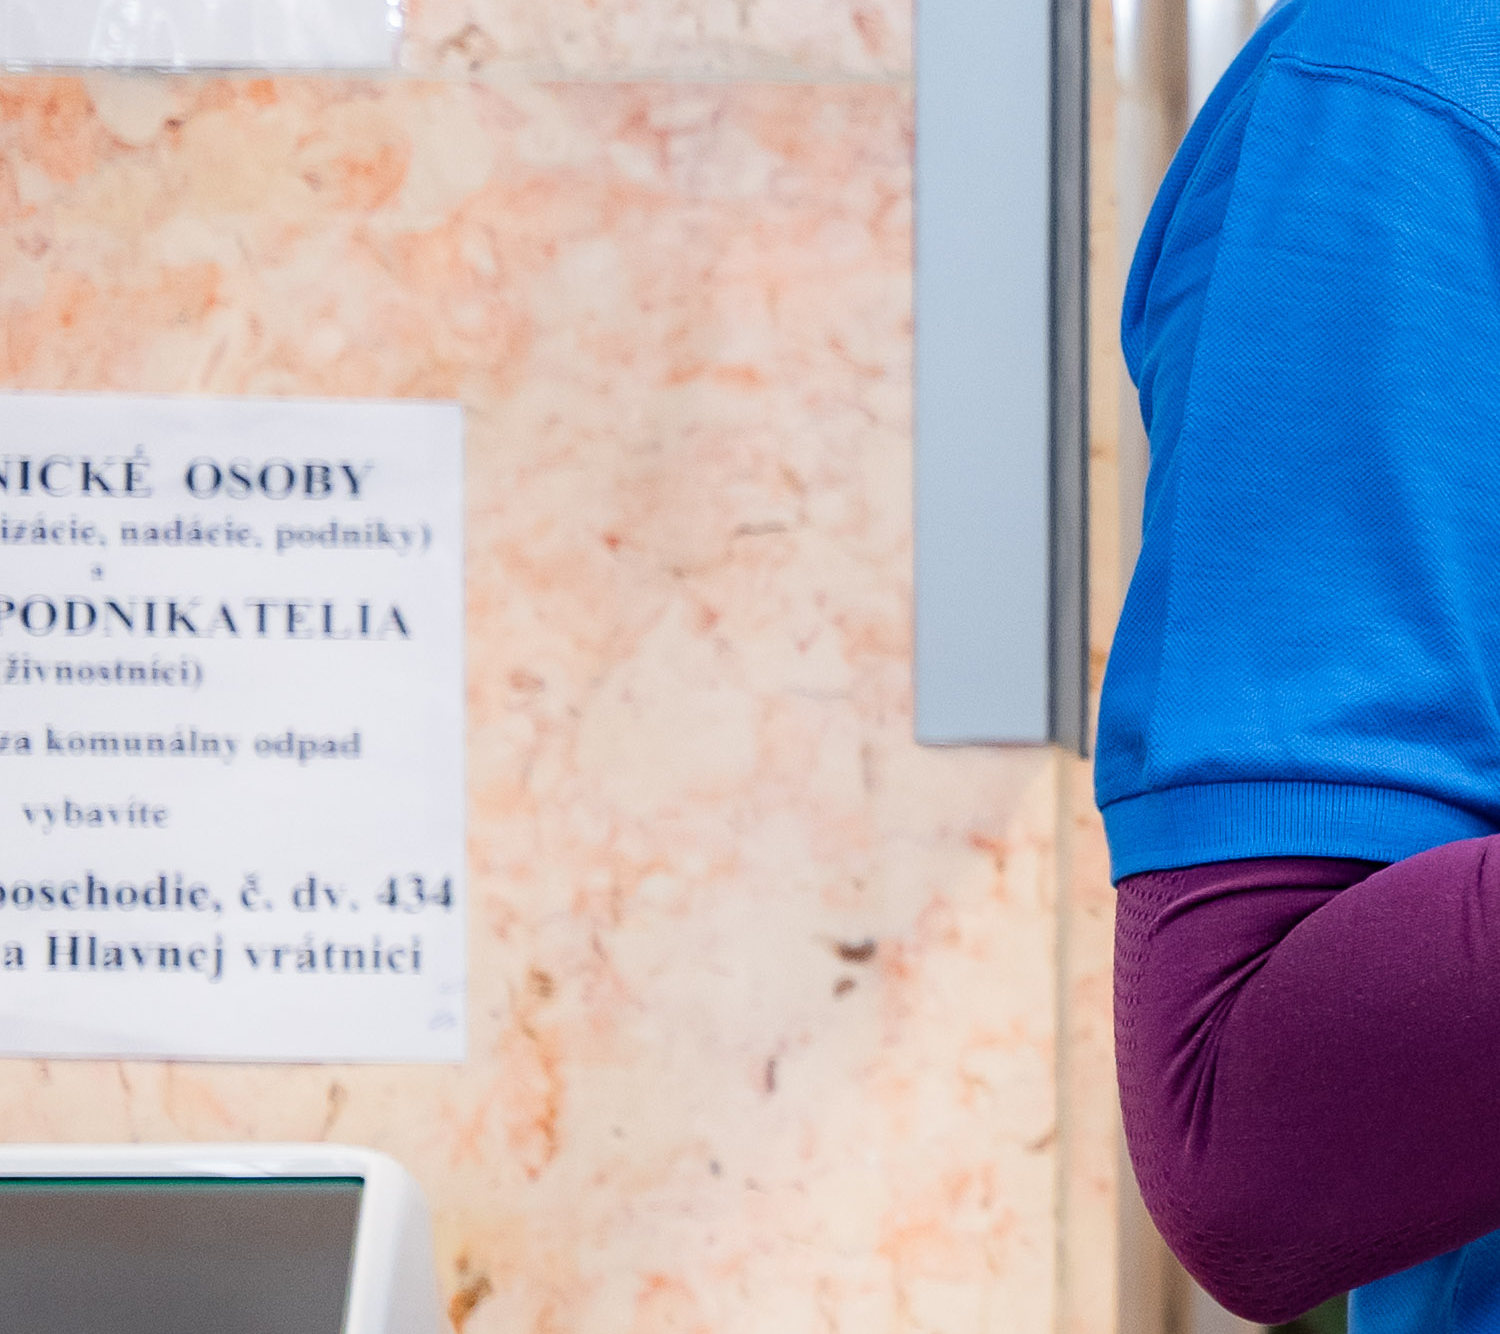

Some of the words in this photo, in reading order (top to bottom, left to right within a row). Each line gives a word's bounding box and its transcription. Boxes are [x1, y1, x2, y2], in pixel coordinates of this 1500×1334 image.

[183, 455, 375, 501] OSOBY
[119, 514, 264, 549] nadácie,
[44, 723, 239, 765] komunálny
[253, 731, 364, 767] odpad
[291, 877, 361, 914] dv.
[374, 873, 457, 916] 434
[45, 930, 227, 984] Hlavnej
